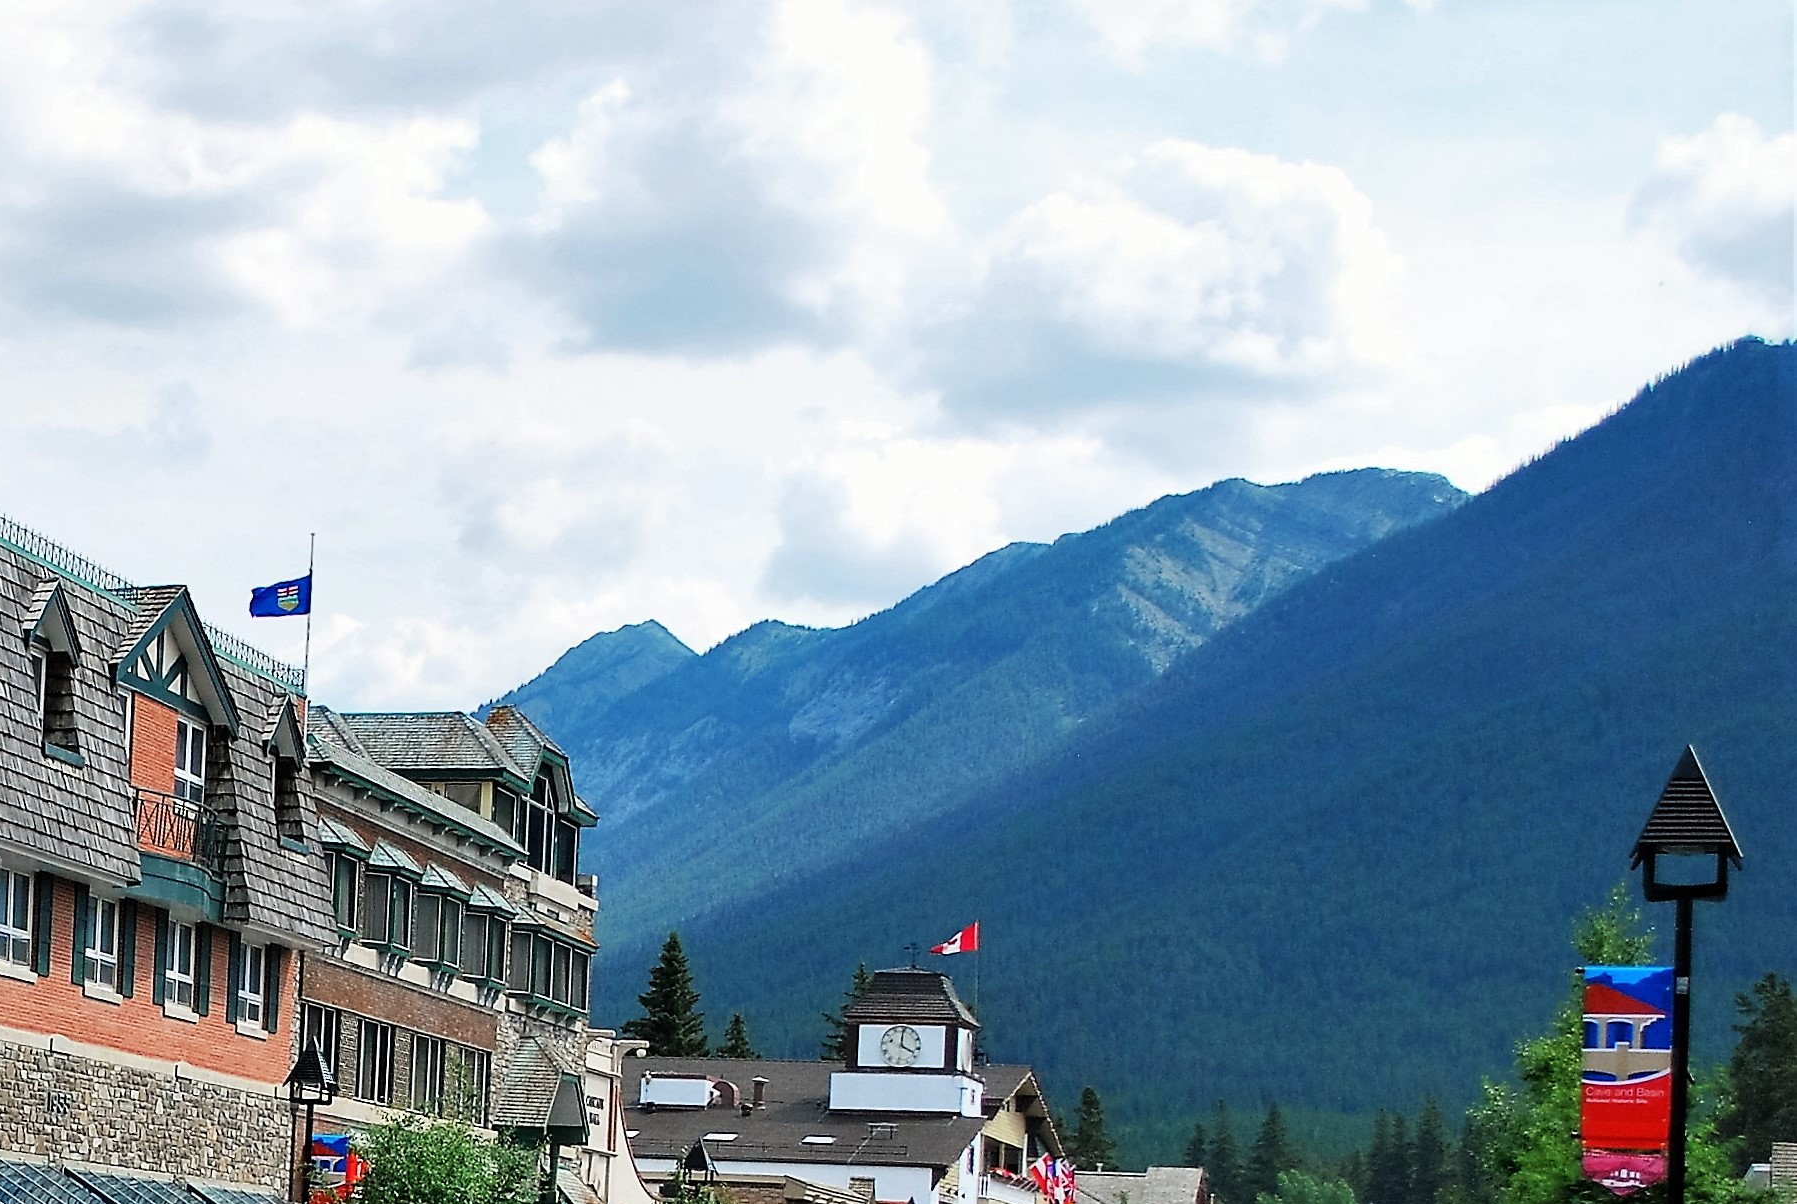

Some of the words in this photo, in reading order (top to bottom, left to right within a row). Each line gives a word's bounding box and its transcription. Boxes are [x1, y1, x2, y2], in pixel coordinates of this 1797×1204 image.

[1585, 1086, 1611, 1097] Cave
[1614, 1086, 1634, 1097] and
[1636, 1087, 1664, 1097] Basin
